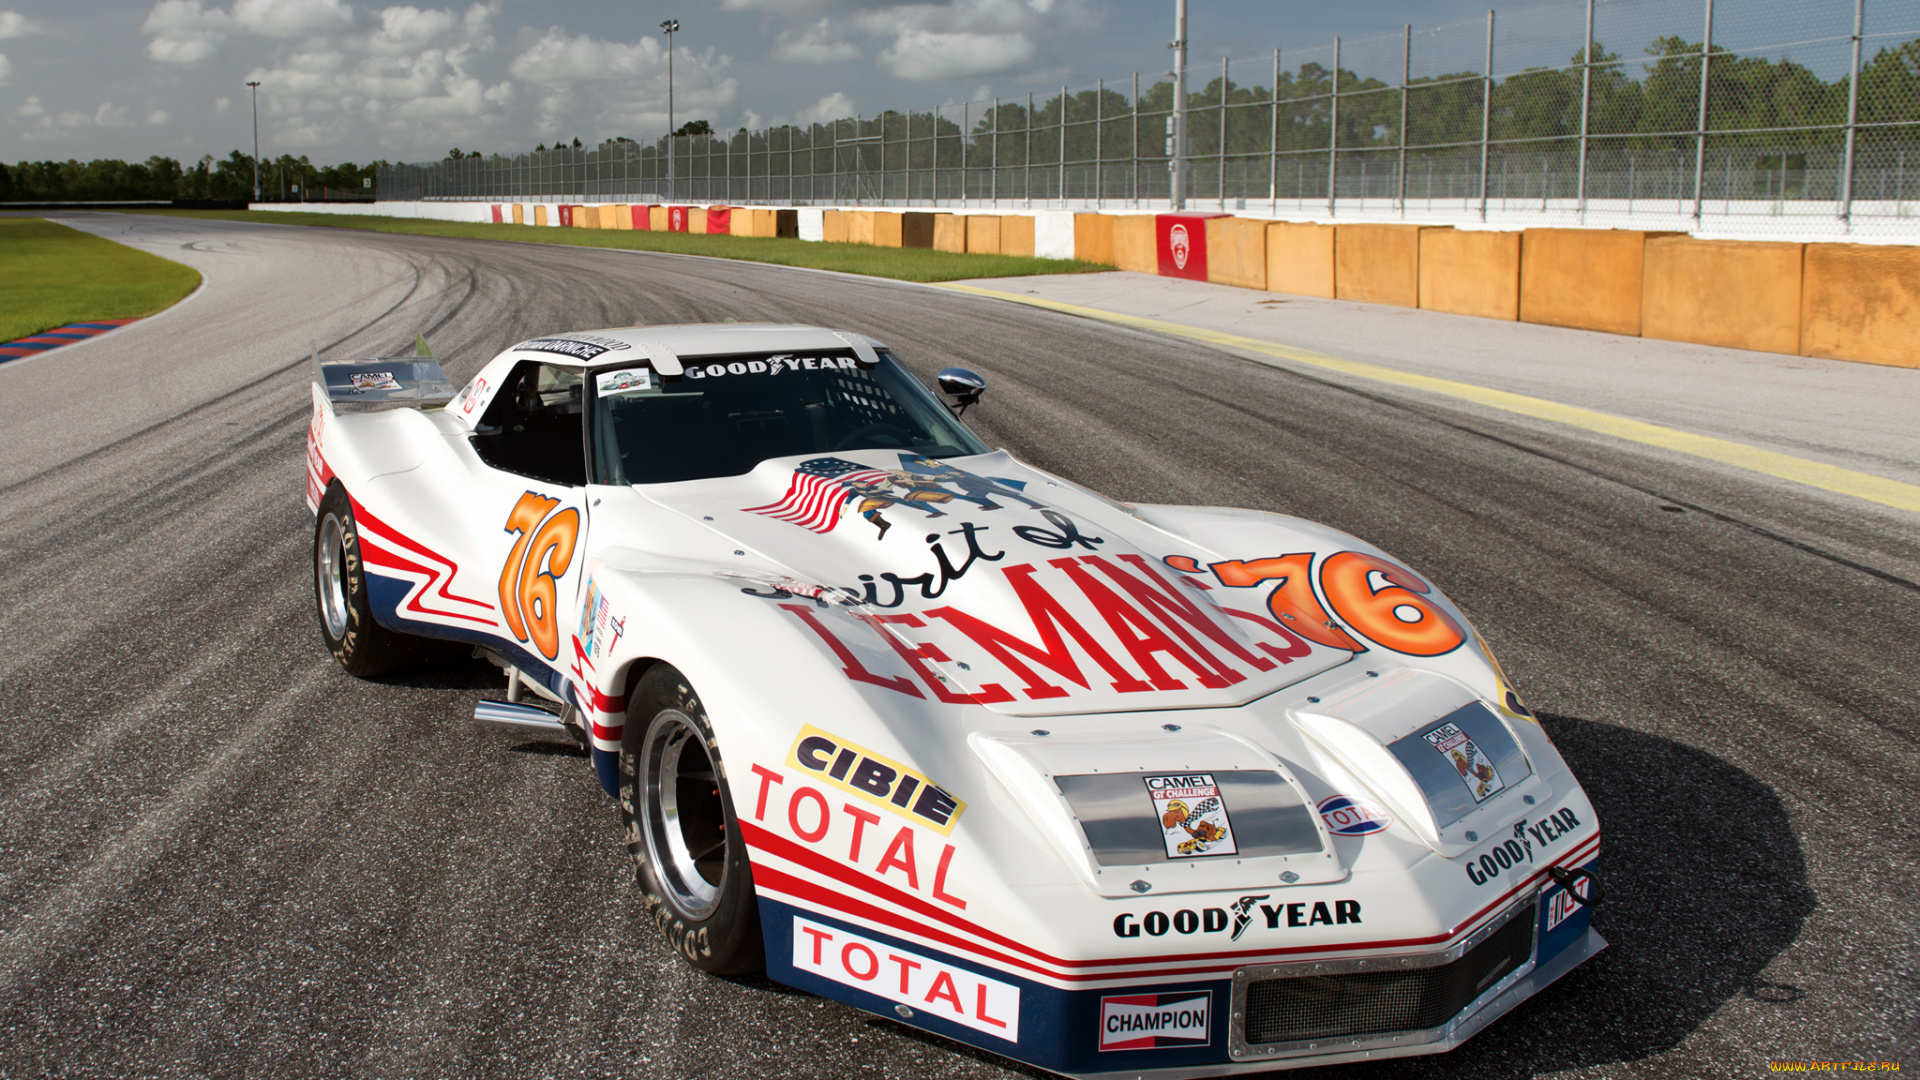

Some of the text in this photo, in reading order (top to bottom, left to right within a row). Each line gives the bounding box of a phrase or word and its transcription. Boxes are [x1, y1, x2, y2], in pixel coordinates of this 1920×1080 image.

[1011, 509, 1105, 551] of
[497, 489, 581, 661] 76
[1425, 723, 1461, 746] CAMEL
[1148, 776, 1214, 790] CAMEL
[1153, 788, 1216, 799] GT CHALLENGE
[1320, 805, 1389, 829] TOTAL
[751, 763, 968, 911] TOTAL
[802, 925, 1008, 1029] TOTAL
[1105, 1009, 1206, 1034] CHAMPION
